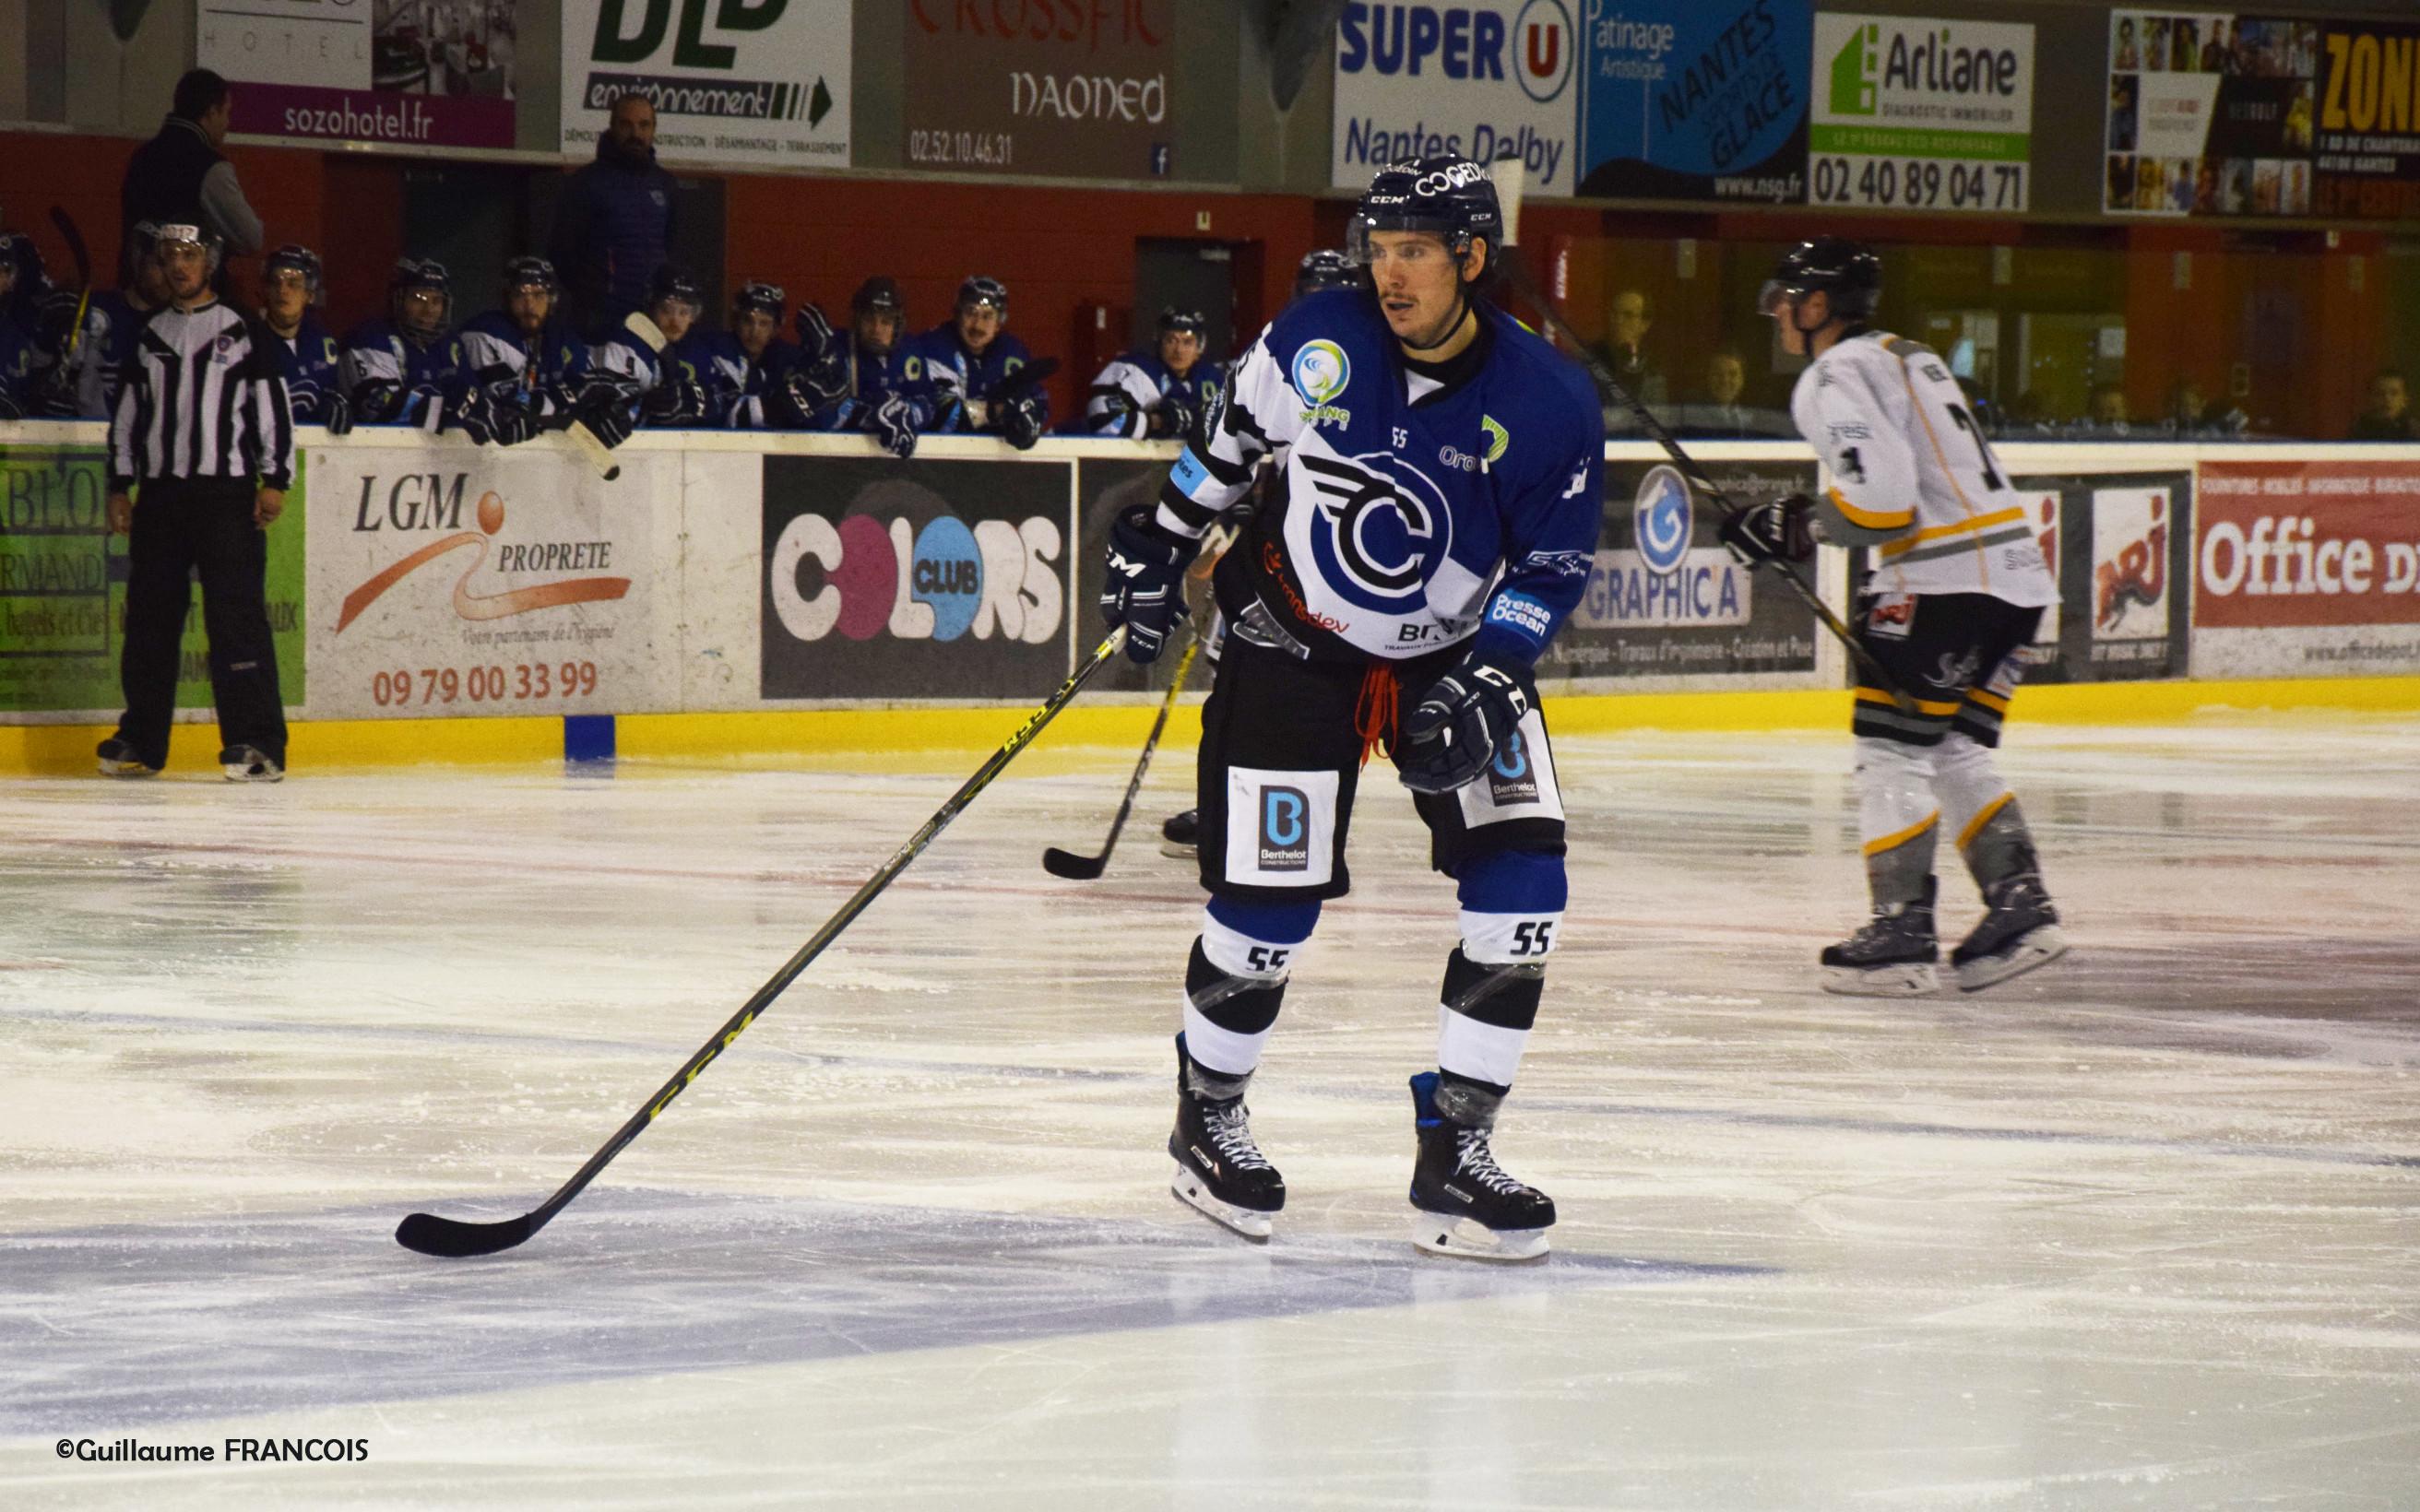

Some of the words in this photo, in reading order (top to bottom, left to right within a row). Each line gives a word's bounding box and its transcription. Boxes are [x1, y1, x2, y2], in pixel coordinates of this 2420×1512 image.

[204, 32, 366, 61] HOTEL
[1340, 3, 1505, 81] SUPER
[1527, 23, 1560, 77] U
[1587, 0, 1675, 60] Patinage
[1660, 0, 1776, 134] NANTES
[1884, 27, 2017, 96] Arliane
[285, 98, 433, 140] sozohotel.fr
[910, 131, 1013, 165] 02.52.10.46.31
[1345, 117, 1463, 167] Nantes
[1472, 124, 1564, 184] Dalby
[1370, 195, 1405, 205] CCM
[1714, 173, 1802, 203] www.nsg.fr
[1815, 158, 1852, 202] 02
[1858, 159, 1896, 204] 40
[1905, 160, 1940, 206] 89
[1949, 163, 1985, 207] 04
[1994, 165, 2021, 208] 71
[1471, 213, 1492, 222] CCM
[353, 472, 469, 533] LGM
[496, 542, 612, 573] PROPRETE
[2201, 515, 2373, 597] Office
[2383, 542, 2420, 595] D
[772, 513, 1063, 644] COLORS
[914, 559, 979, 595] CLUB
[1495, 594, 1551, 624] Presse
[1131, 633, 1156, 650] CCM
[374, 670, 412, 706] 09
[421, 667, 459, 703] 79
[468, 665, 506, 702] 00
[515, 663, 552, 699] 33
[560, 661, 598, 697] 99
[1493, 783, 1537, 795] Berthelot
[1261, 848, 1307, 859] Berthelot
[1510, 921, 1554, 956] 55
[1246, 946, 1289, 973] 55
